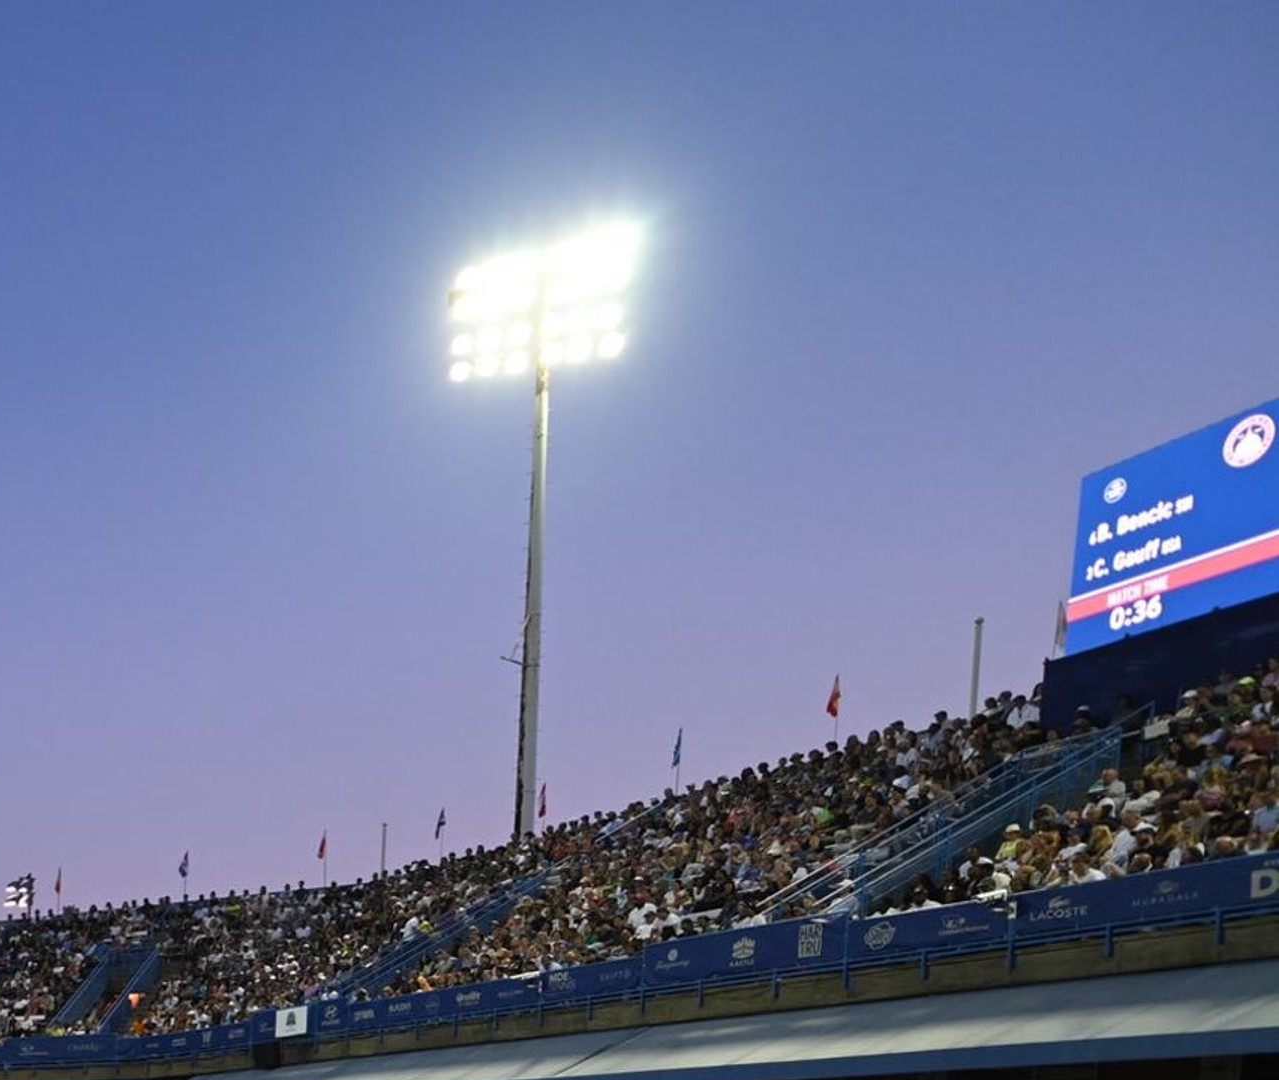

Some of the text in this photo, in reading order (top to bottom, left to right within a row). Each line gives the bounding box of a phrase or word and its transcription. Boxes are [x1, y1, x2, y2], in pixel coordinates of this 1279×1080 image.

[1117, 501, 1173, 536] Bencic
[1093, 558, 1109, 578] C.
[1113, 538, 1160, 571] Gauff
[1109, 594, 1162, 630] 0:36
[1250, 869, 1279, 898] D
[1030, 907, 1088, 922] LACOSTE
